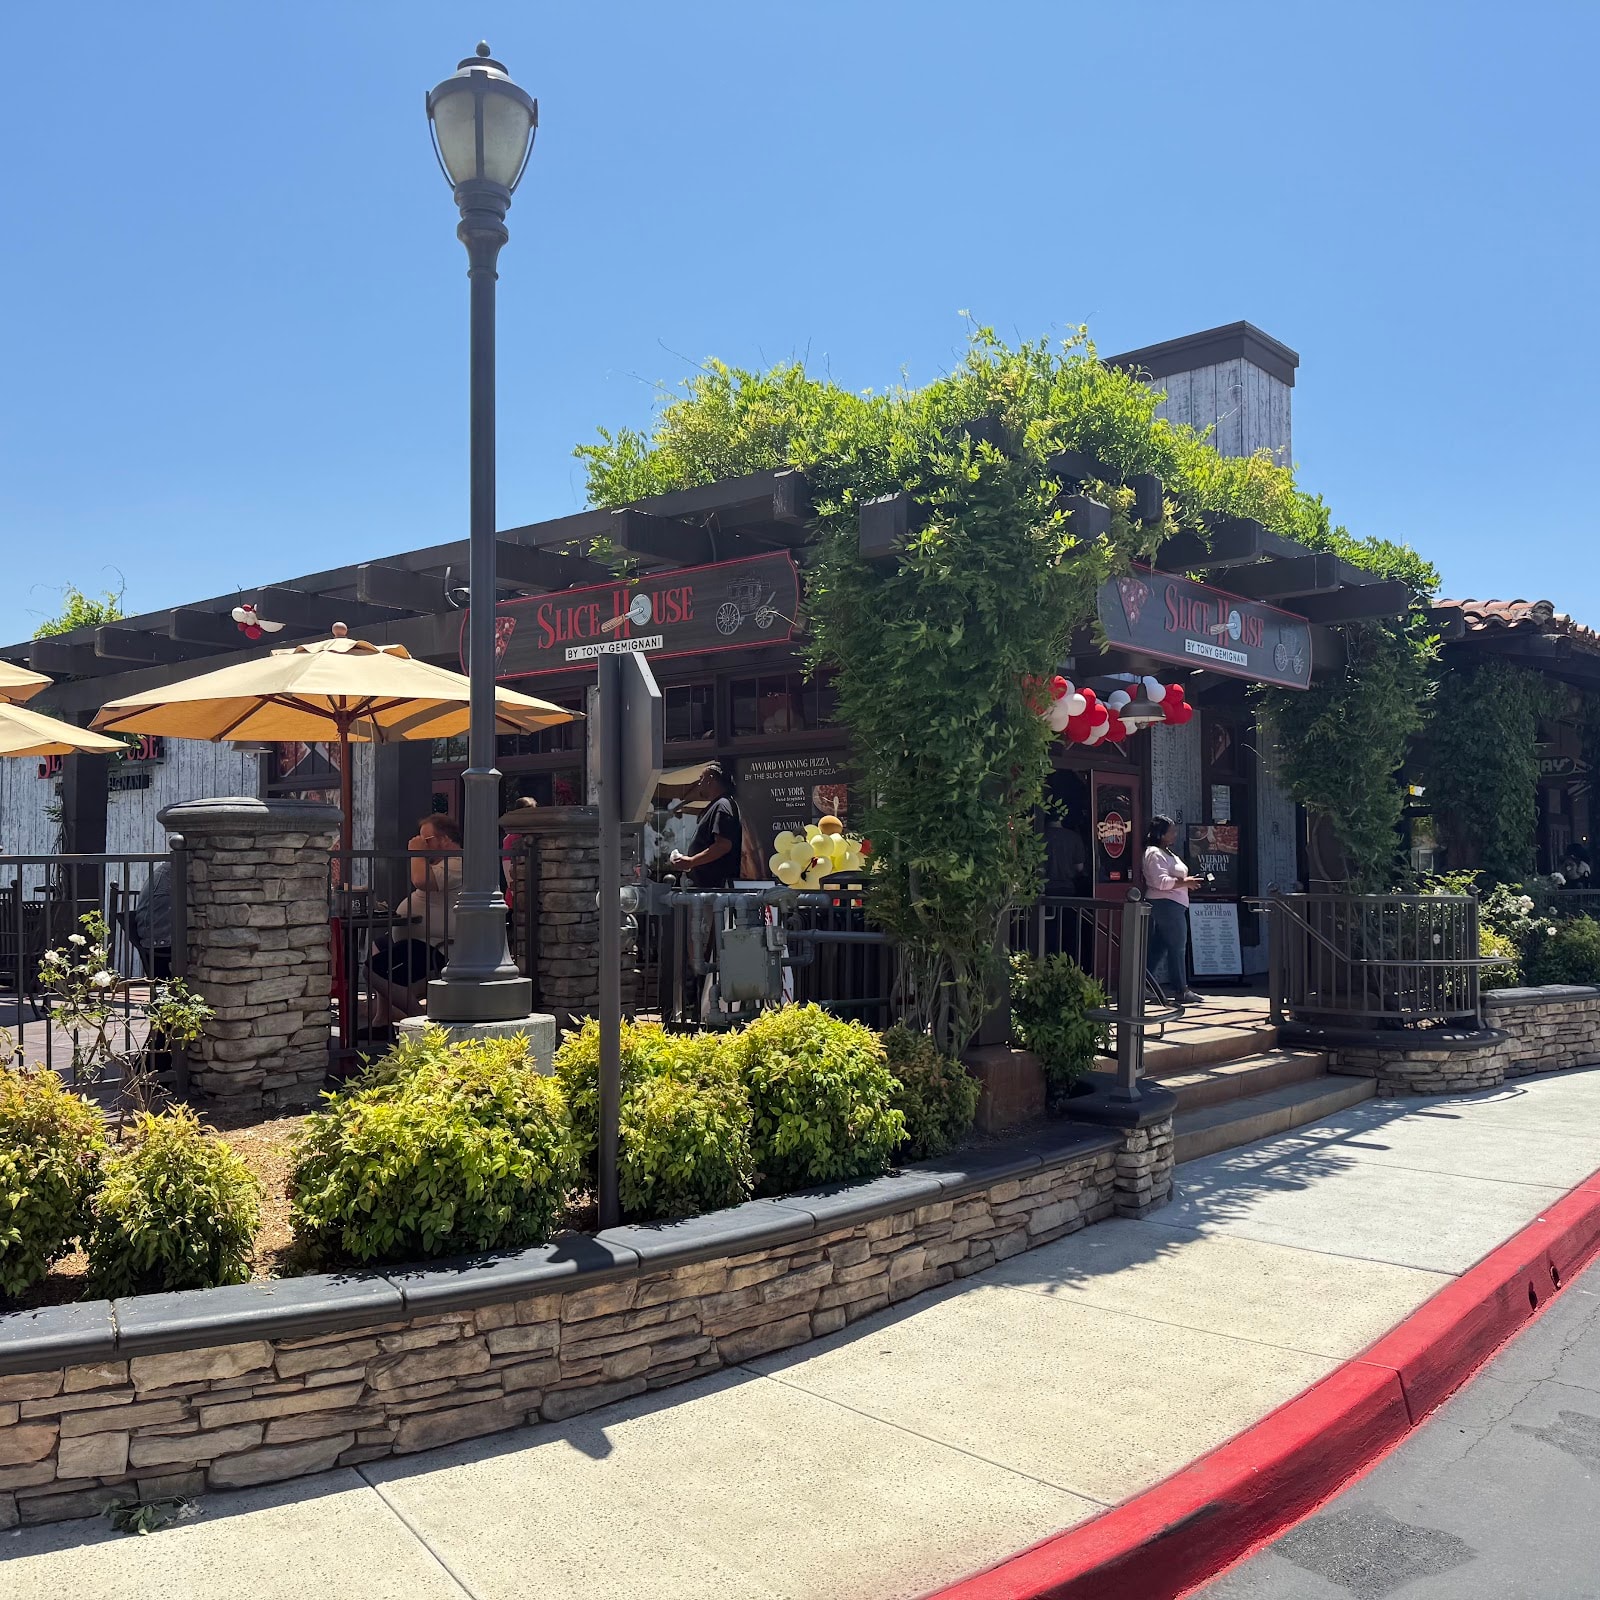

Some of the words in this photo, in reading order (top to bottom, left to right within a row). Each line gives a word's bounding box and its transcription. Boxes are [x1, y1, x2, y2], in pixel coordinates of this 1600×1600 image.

[1165, 584, 1210, 634] SLICE
[538, 603, 601, 649] SLICE
[567, 649, 578, 659] BY
[581, 645, 606, 656] TONY
[608, 636, 662, 653] GEMIGNANI
[1187, 641, 1195, 652] BY
[1197, 645, 1213, 656] TONY
[751, 762, 777, 771] AWARD
[777, 759, 808, 769] WINNING
[809, 757, 830, 767] PIZZA
[784, 771, 794, 779] OR
[819, 768, 836, 776] PIZZA
[770, 788, 786, 797] NEW
[787, 787, 805, 796] YORK
[1197, 854, 1230, 864] WEEKDAY
[1199, 863, 1228, 872] SPECIAL
